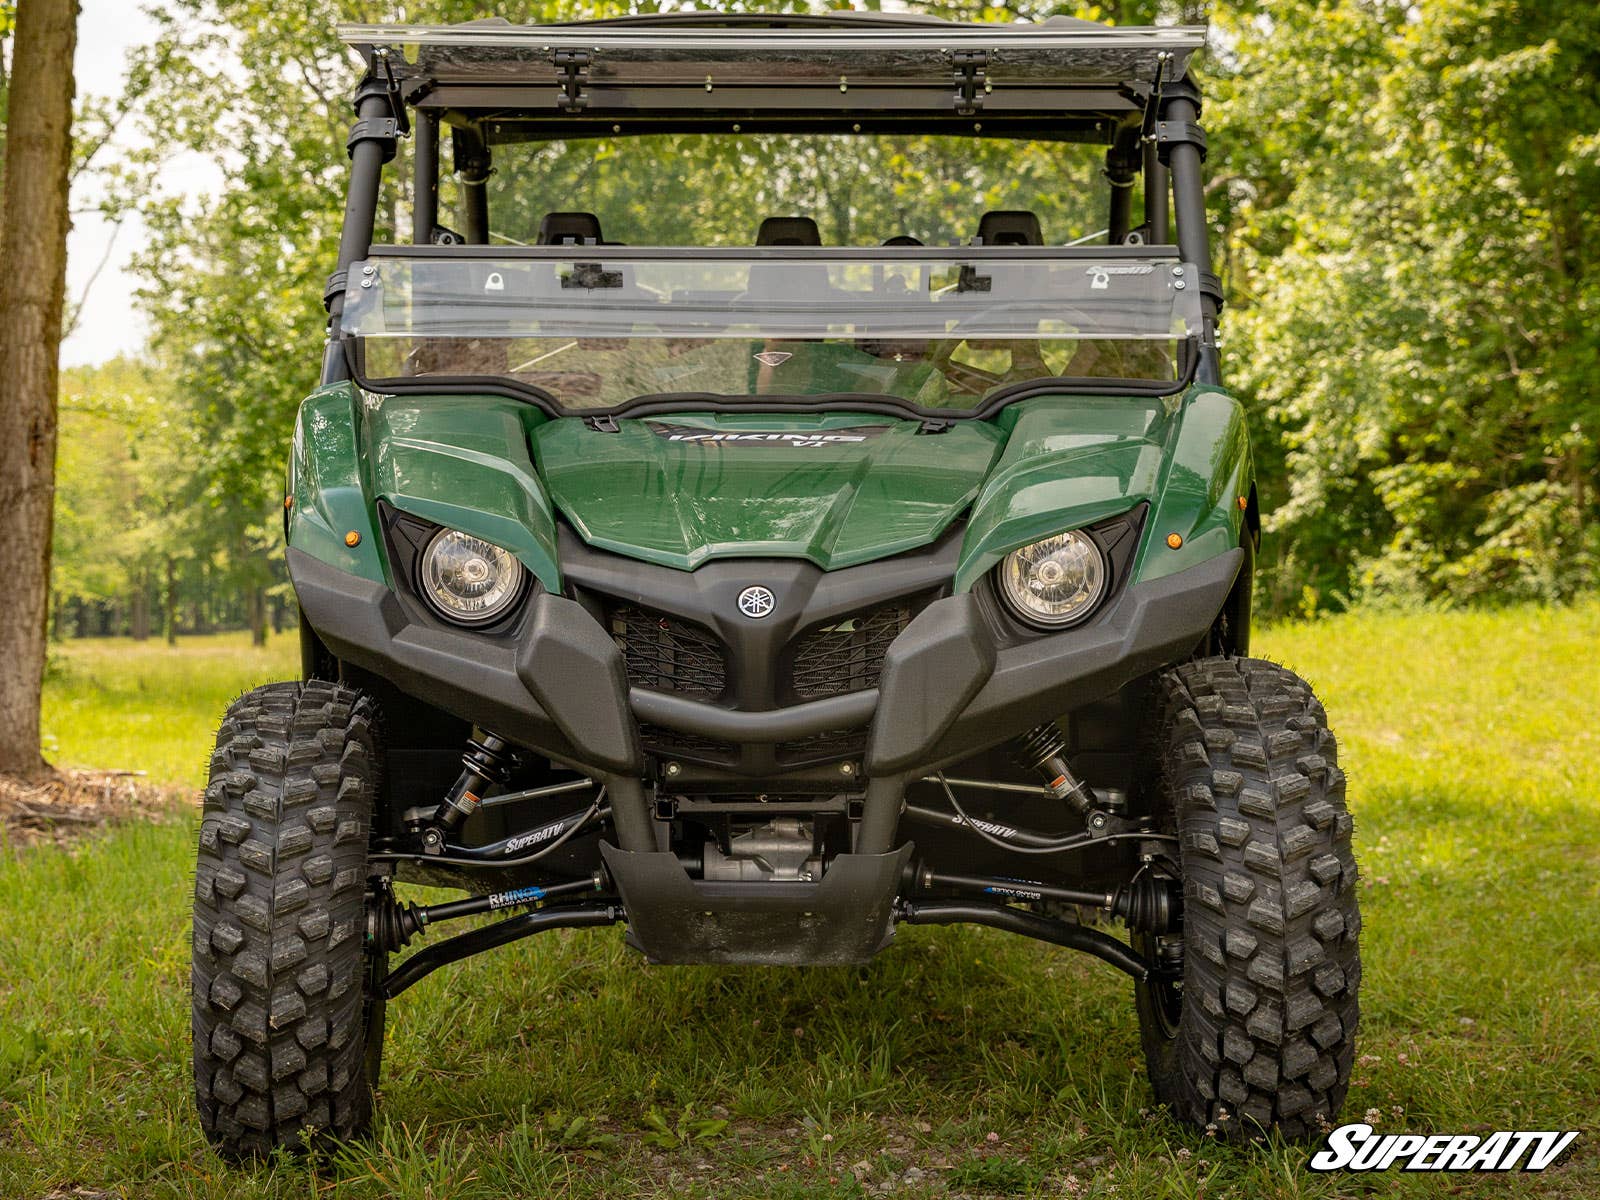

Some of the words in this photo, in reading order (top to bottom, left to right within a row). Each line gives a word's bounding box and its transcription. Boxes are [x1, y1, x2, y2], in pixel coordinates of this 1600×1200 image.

[668, 433, 867, 442] VIKING
[504, 822, 565, 854] SUPERATV
[488, 888, 533, 905] RHINO
